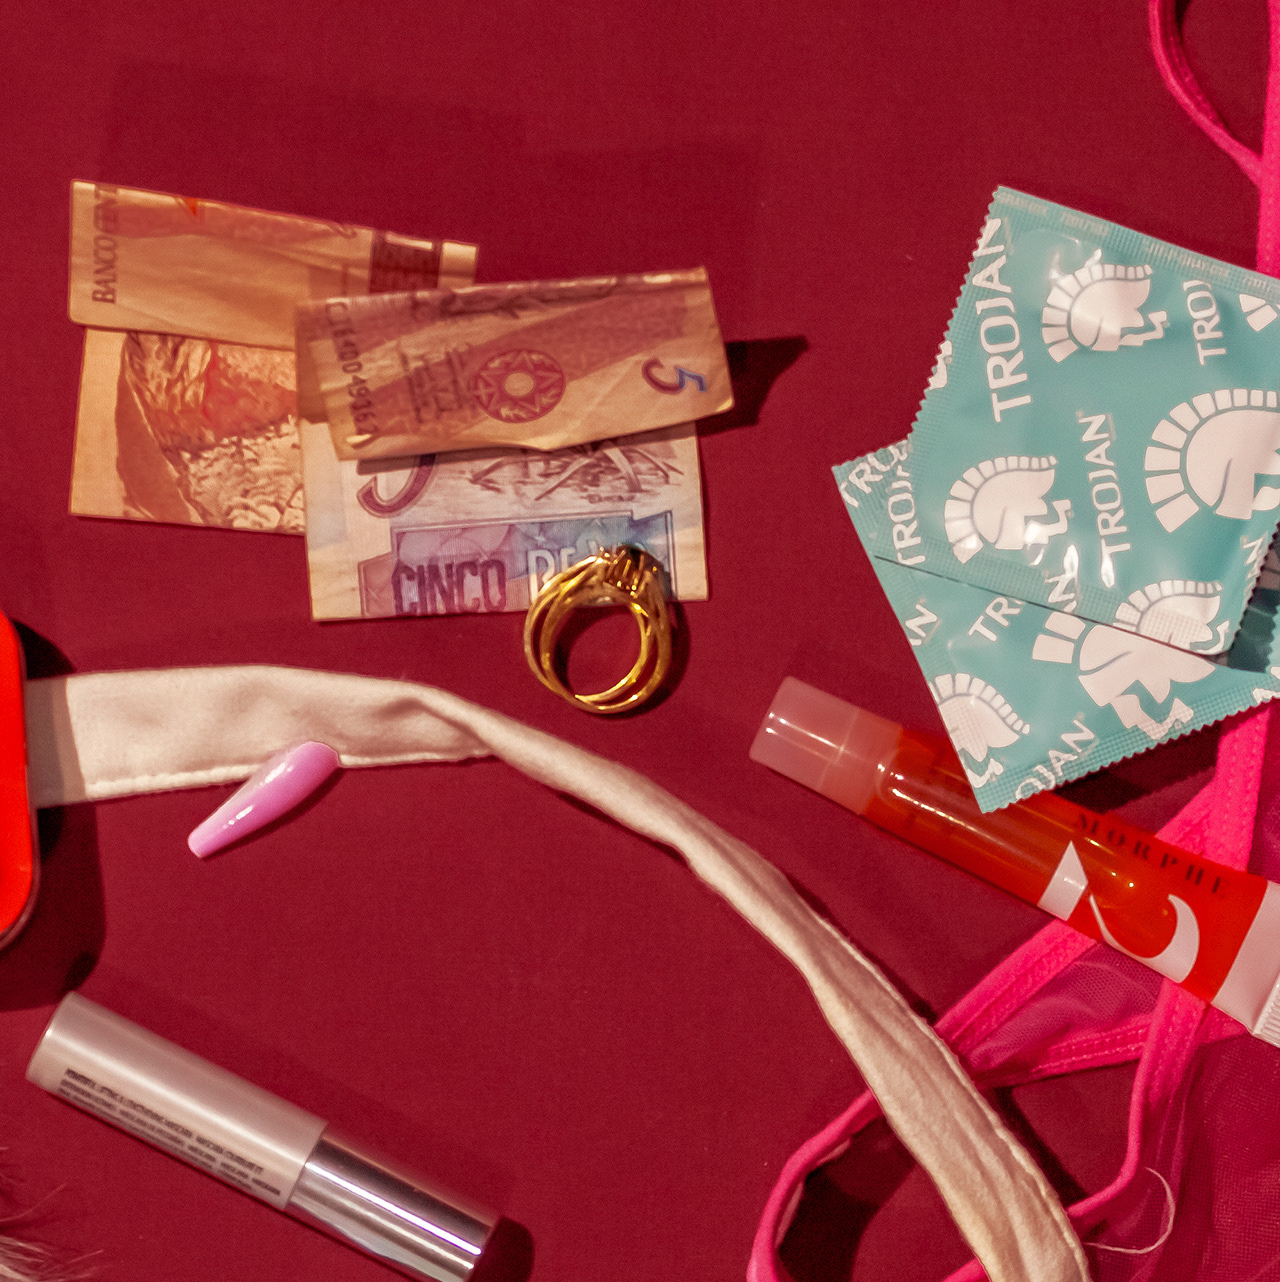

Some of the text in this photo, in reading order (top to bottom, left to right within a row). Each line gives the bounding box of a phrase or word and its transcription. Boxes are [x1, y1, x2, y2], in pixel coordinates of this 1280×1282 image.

[91, 235, 116, 303] BANCO
[972, 217, 1031, 423] TROJAN
[1077, 414, 1132, 588] TROJAN
[392, 559, 507, 615] CINCO
[1069, 812, 1234, 898] MORPHE
